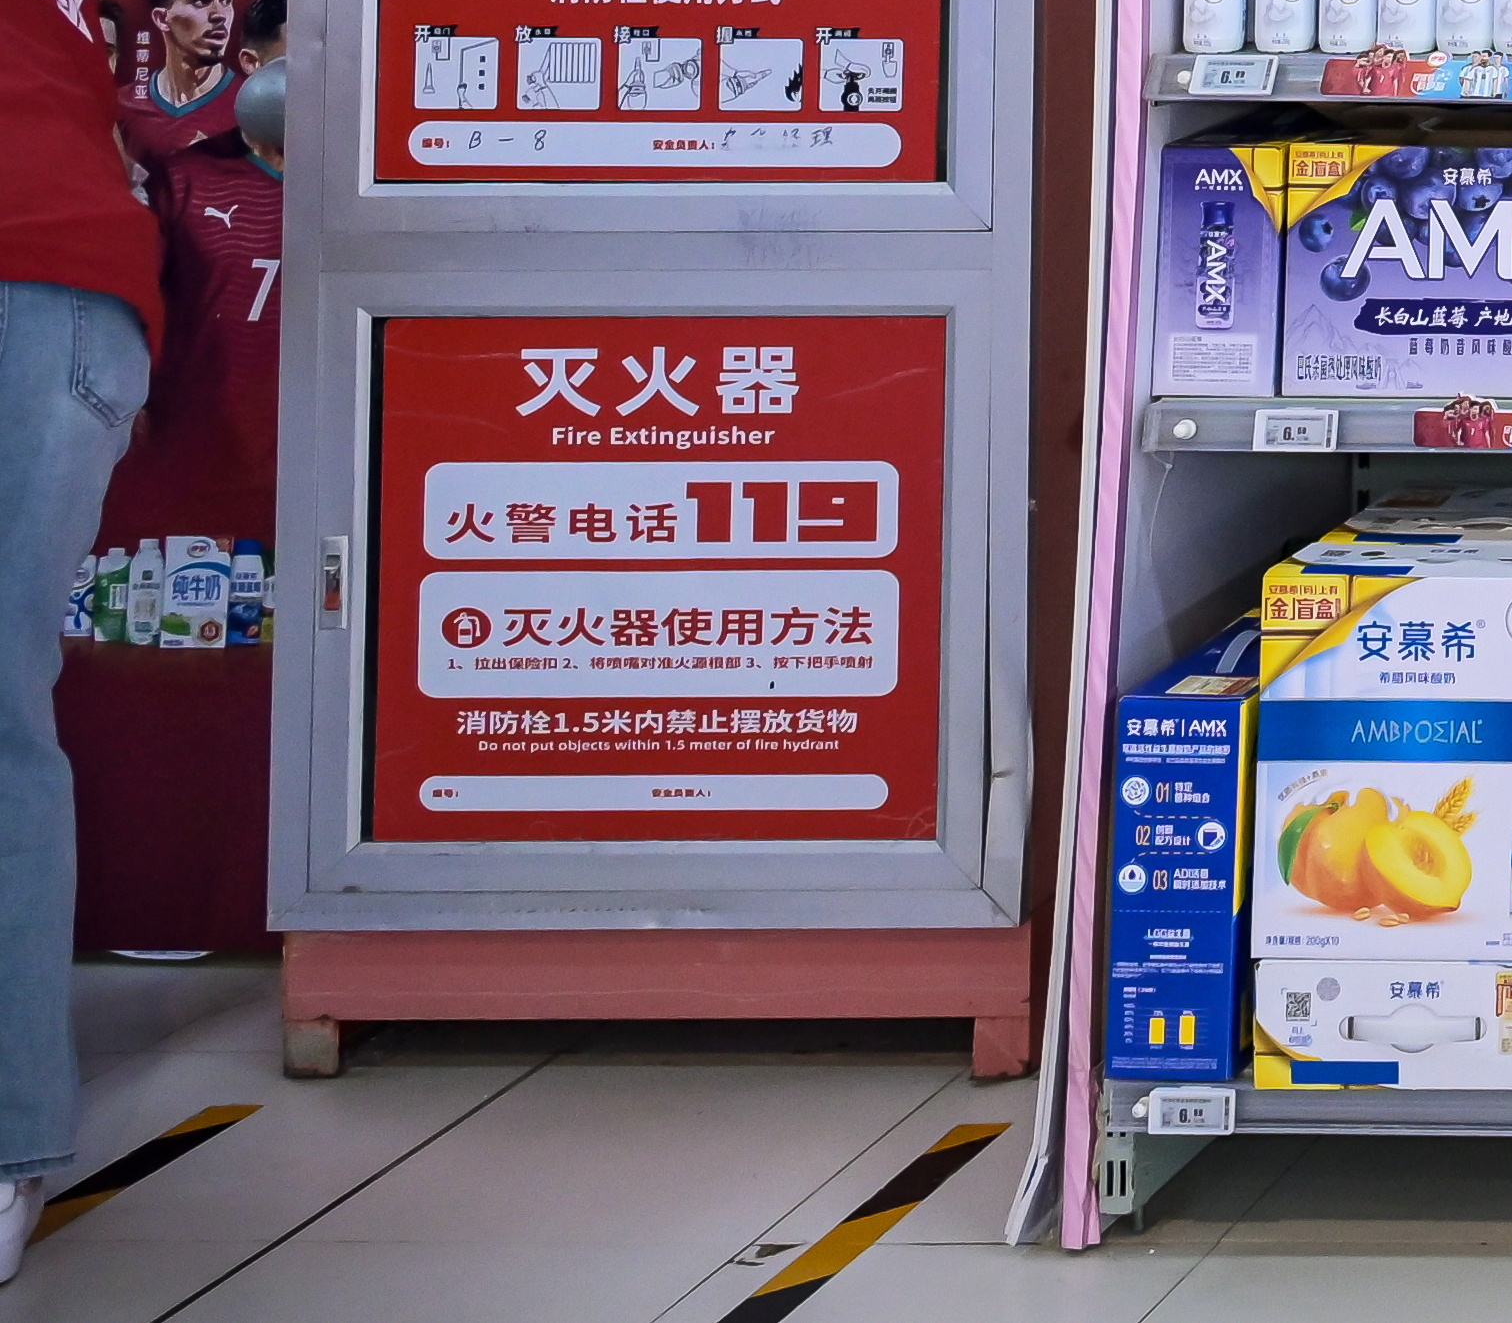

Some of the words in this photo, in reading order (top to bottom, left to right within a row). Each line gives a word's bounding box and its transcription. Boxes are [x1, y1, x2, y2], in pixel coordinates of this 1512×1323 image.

[1443, 168, 1492, 185] 安慕希
[245, 259, 281, 323] 7
[1375, 307, 1468, 327] 长白山蓝莓
[516, 345, 800, 418] 灭火器
[551, 425, 601, 447] Fire
[610, 425, 775, 449] Extinguisher
[446, 502, 678, 545] 火警电话
[686, 481, 879, 544] 119
[503, 607, 873, 646] 灭火器使用方法
[1356, 621, 1477, 663] 安慕希
[1379, 671, 1456, 688] 希腊风味酸奶
[457, 710, 858, 734] 消防栓1.5米内禁止摆放货物
[479, 739, 497, 751] Do
[501, 739, 526, 751] not
[531, 739, 554, 753] put
[558, 739, 611, 753] objects
[615, 739, 660, 751] within
[665, 739, 685, 751] 1.5
[690, 739, 732, 751] meter
[736, 739, 751, 751] of
[755, 739, 778, 751] fire
[783, 739, 839, 753] hydrant
